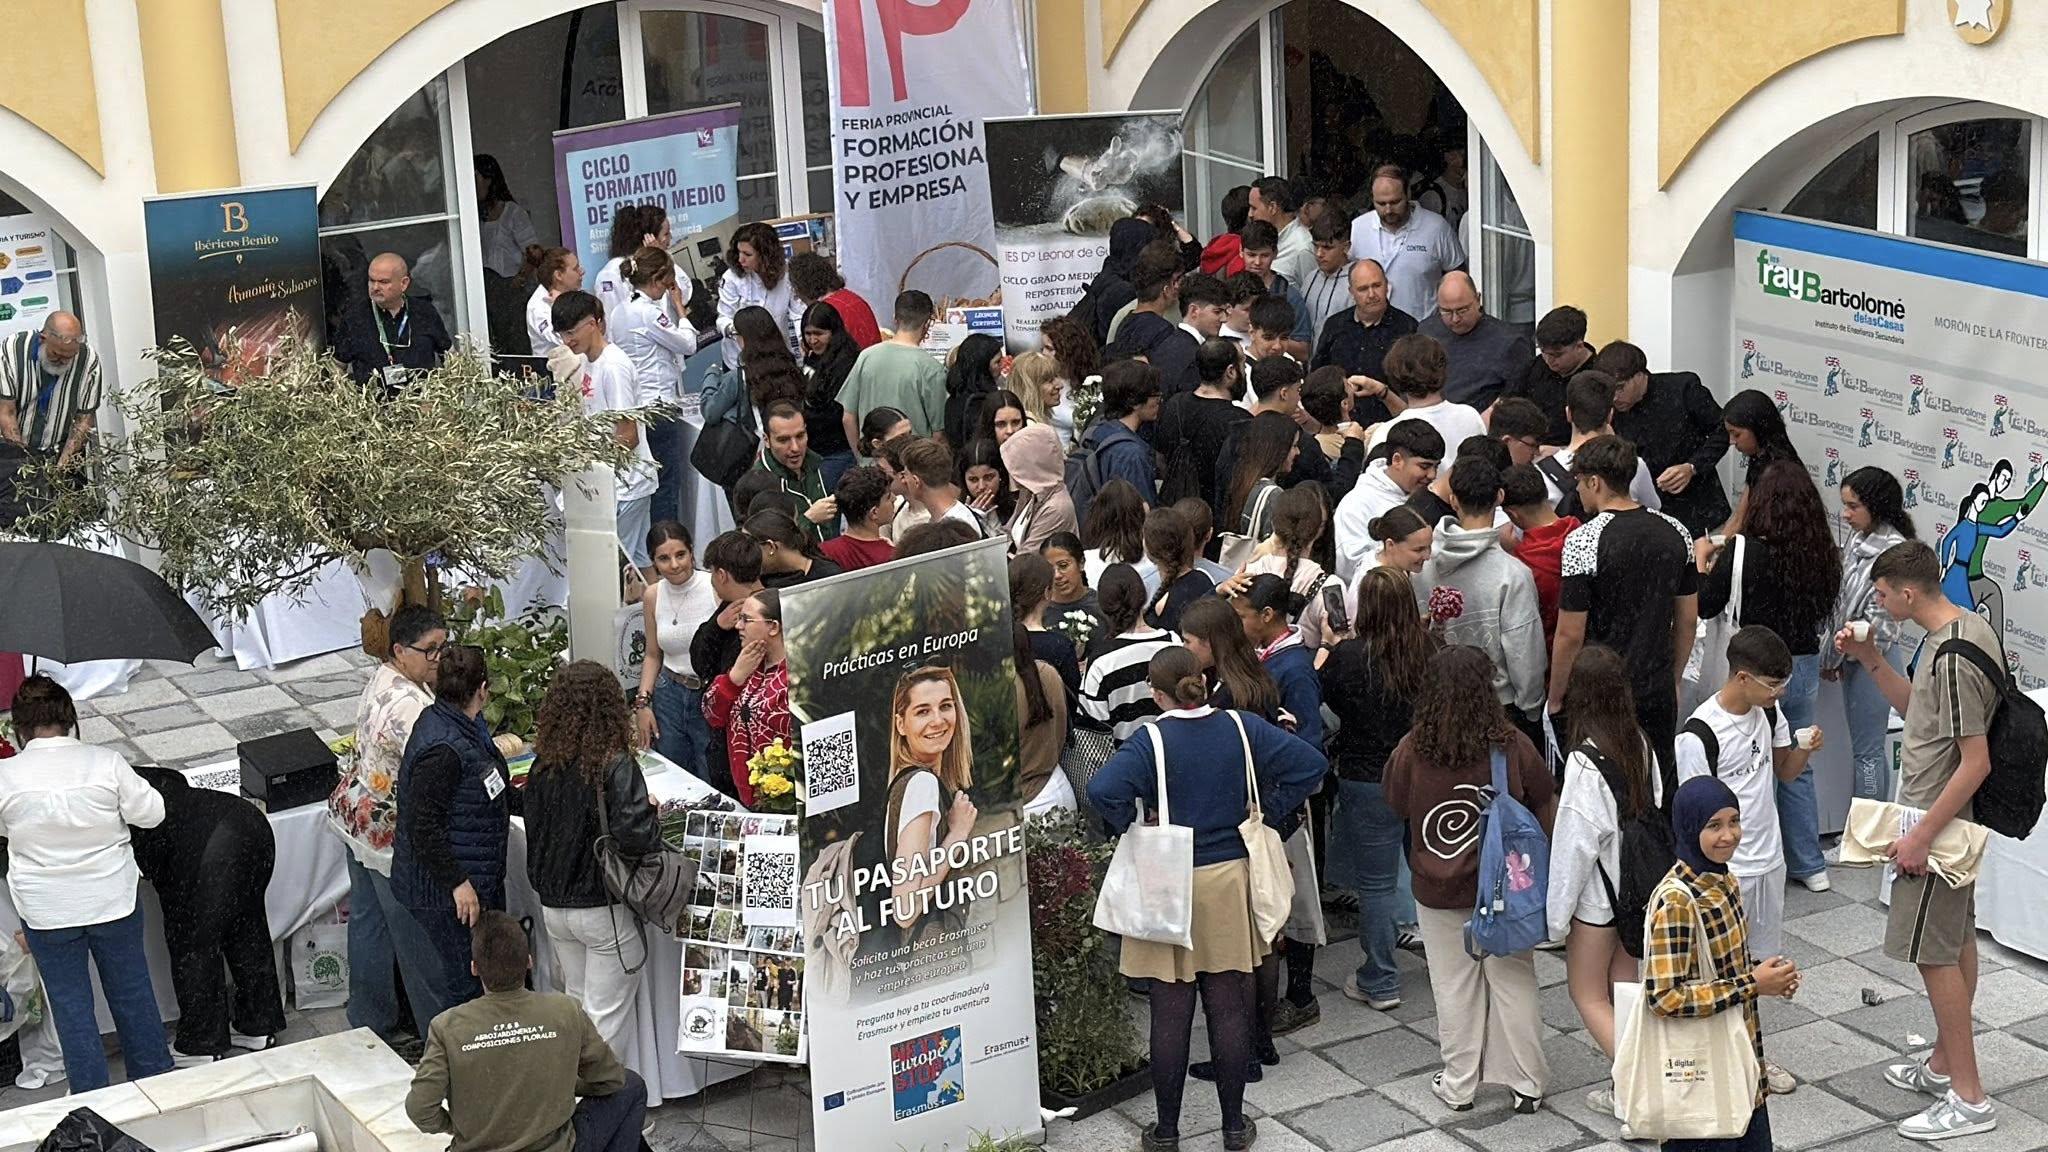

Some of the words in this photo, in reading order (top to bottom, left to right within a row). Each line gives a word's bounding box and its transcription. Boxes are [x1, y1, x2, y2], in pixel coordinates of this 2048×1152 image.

[842, 118, 883, 130] FERIA
[886, 104, 953, 127] PROVINCIAL
[843, 119, 974, 158] FORMACIÓN
[581, 153, 630, 180] CICLO
[584, 168, 677, 203] FORMATIVO
[844, 191, 861, 210] Y
[869, 175, 967, 209] EMPRESA
[220, 202, 249, 233] B
[587, 204, 609, 226] DE
[672, 183, 726, 210] MEDIO
[15, 231, 46, 241] TURISMO
[194, 237, 240, 251] Ibéricos
[241, 234, 279, 247] Benito
[1406, 244, 1427, 252] CONTROL
[1005, 250, 1018, 263] IES
[1038, 249, 1074, 261] Leonor
[1077, 247, 1093, 258] de
[228, 277, 275, 304] Armonía
[277, 277, 318, 299] Sabores
[1003, 276, 1028, 285] CICLO
[1030, 273, 1066, 284] GRADO
[1025, 286, 1083, 299] REPOSTERÍA
[1875, 331, 1905, 344] Secundaria
[1934, 316, 1971, 334] MORÓN
[1973, 324, 1987, 338] DE
[1989, 328, 2002, 340] LA
[2005, 330, 2048, 350] FRONTER
[822, 648, 895, 680] Prácticas
[898, 643, 918, 660] en
[923, 627, 979, 655] Europa
[804, 872, 845, 911] TU
[852, 825, 1023, 896] PASAPORTE
[835, 905, 872, 940] AL
[879, 869, 999, 927] FUTURO
[851, 951, 889, 970] Solicita
[891, 946, 910, 958] una
[912, 937, 937, 951] beca
[938, 924, 988, 944] Erasmus+
[855, 976, 862, 987] y
[863, 969, 882, 982] haz
[885, 963, 901, 976] tus
[902, 950, 949, 973] prácticas
[951, 946, 963, 956] en
[966, 939, 985, 951] una
[877, 974, 922, 994] empresa
[923, 961, 966, 982] europea
[856, 1010, 895, 1029] Pregunta
[896, 1004, 912, 1019] hoy
[913, 1004, 919, 1012] a
[921, 1000, 930, 1009] tu
[931, 982, 990, 1006] coordinador/a
[857, 1023, 898, 1041] Erasmus+
[900, 1022, 906, 1031] y
[906, 1010, 941, 1026] empieza
[942, 1007, 951, 1016] tu
[953, 996, 990, 1013] aventura
[461, 1036, 522, 1051] COMPOSICIONES
[522, 1031, 557, 1042] FLORALES
[984, 1035, 1030, 1055] Erasmus+
[892, 1045, 945, 1075] Europe
[895, 1059, 945, 1093] STOP
[895, 1098, 947, 1120] Erasmus+
